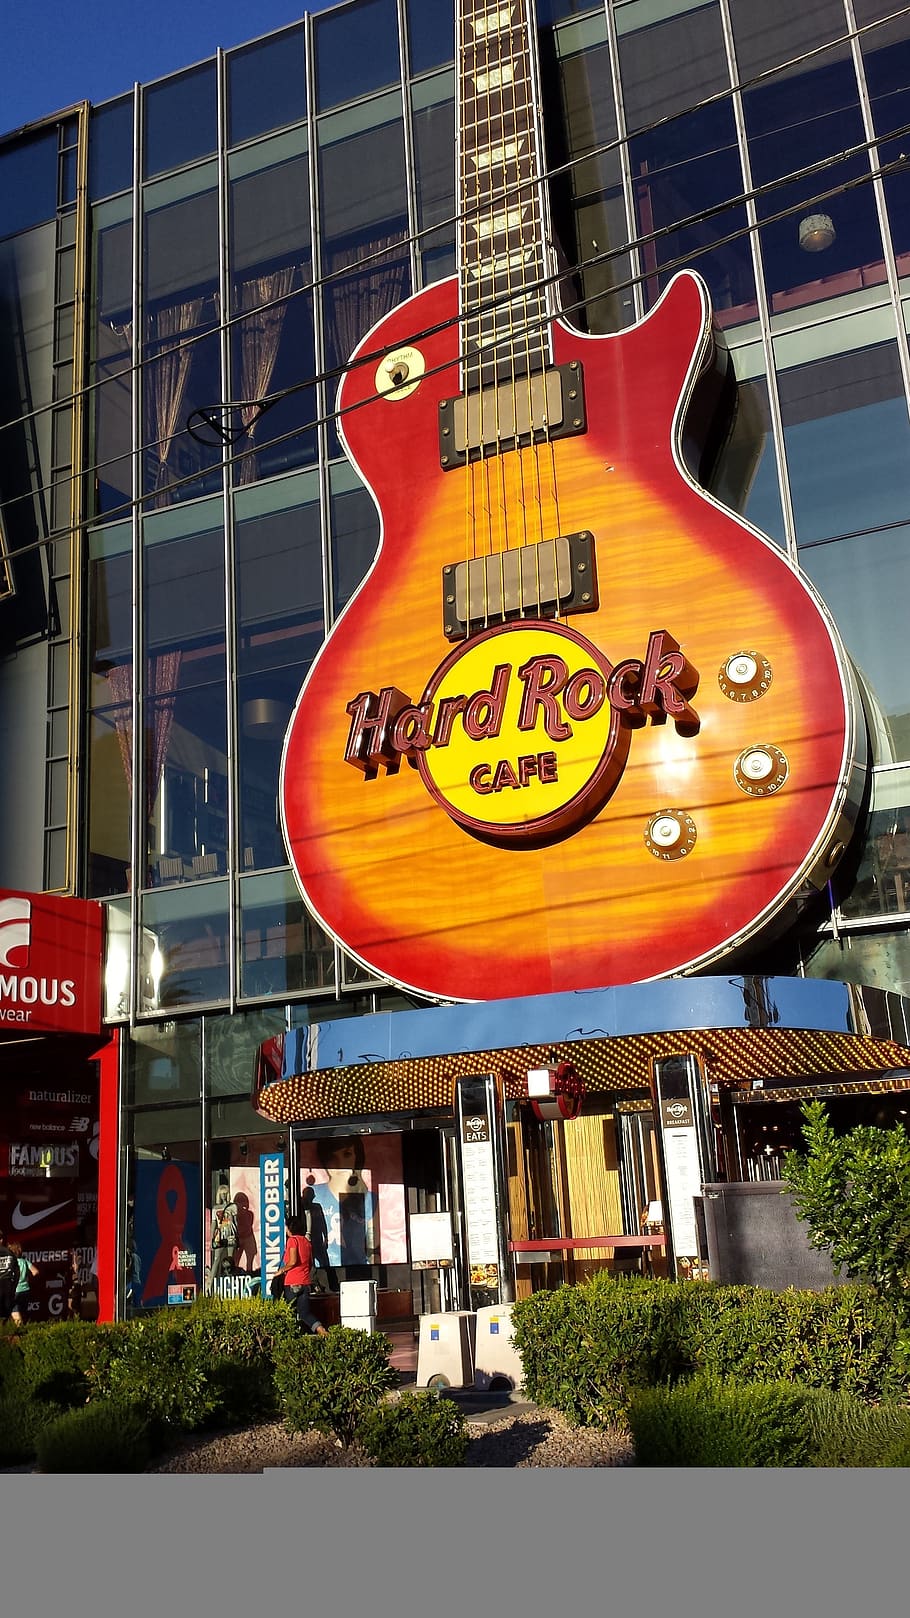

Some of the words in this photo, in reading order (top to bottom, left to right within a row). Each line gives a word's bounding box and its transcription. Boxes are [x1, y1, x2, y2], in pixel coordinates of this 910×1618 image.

[342, 662, 514, 778] Hard
[517, 629, 694, 743] Rock
[469, 751, 558, 794] CAFE
[767, 783, 777, 792] 10
[0, 974, 76, 1007] MOUS
[29, 1090, 92, 1104] naturalizer
[466, 1131, 487, 1141] EATS
[11, 1145, 76, 1167] FAMOUS
[48, 1294, 64, 1316] G
